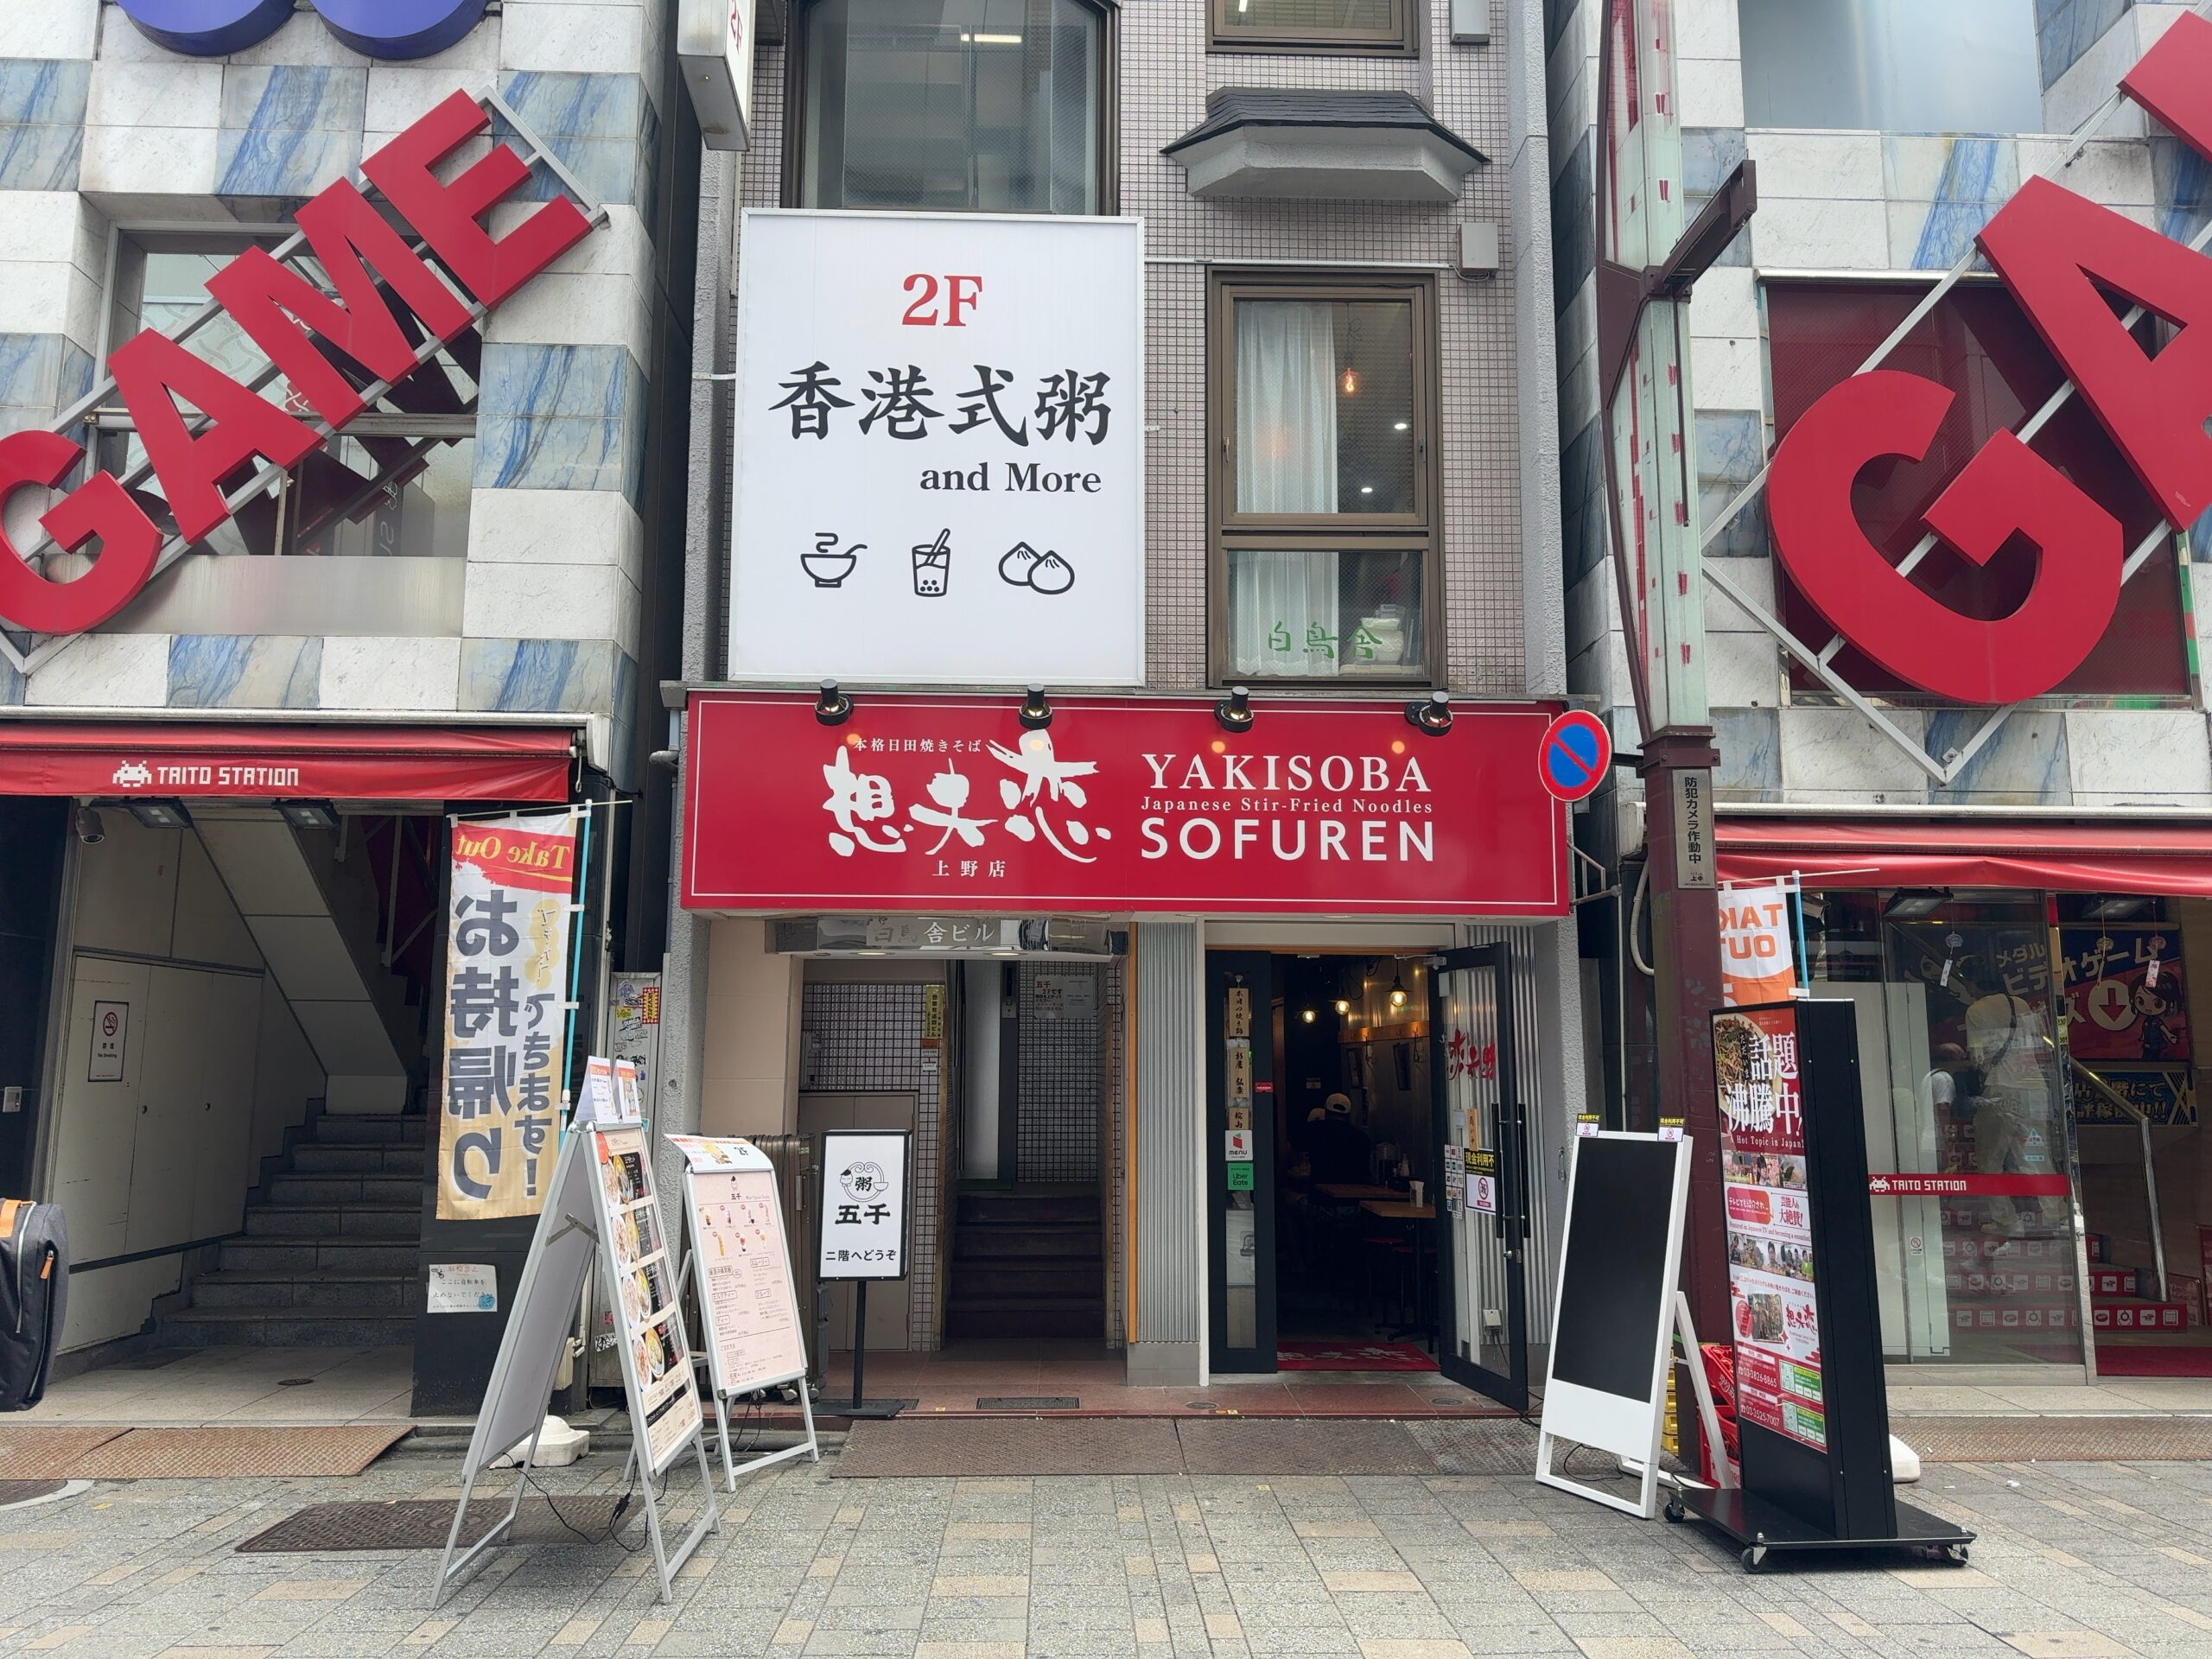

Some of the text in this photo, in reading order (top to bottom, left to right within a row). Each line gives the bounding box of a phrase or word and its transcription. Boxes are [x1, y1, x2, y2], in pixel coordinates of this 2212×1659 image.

[901, 273, 983, 327] 2F
[0, 88, 594, 634] GAME
[1767, 10, 2212, 704] GA
[767, 360, 1112, 448] 香港式粥
[919, 461, 1102, 493] and More
[1268, 620, 1382, 659] 白鳥舎
[853, 738, 982, 753] 本格日田焼きそば
[157, 767, 299, 786] TAITO STATION
[1141, 753, 1432, 792] YAKISOBA
[823, 729, 1111, 863] 想夫恋
[1141, 796, 1433, 814] Japanese Stir-Fried Noodles
[1684, 777, 1701, 864] 防犯カメラ作動中
[1141, 817, 1433, 862] SOFUREN
[931, 860, 1007, 878] 上野店
[1749, 1031, 1799, 1080] 話題
[1465, 1151, 1495, 1166] 現金利用不
[1737, 1135, 1748, 1145] Hot
[1751, 1136, 1769, 1148] Topic
[1771, 1138, 1778, 1147] in
[1781, 1138, 1805, 1150] Japan!
[855, 1176, 873, 1192] 粥
[1891, 1179, 1967, 1192] TAITO STATION
[835, 1203, 891, 1225] 五千
[825, 1249, 897, 1262] 二階へどうぞ
